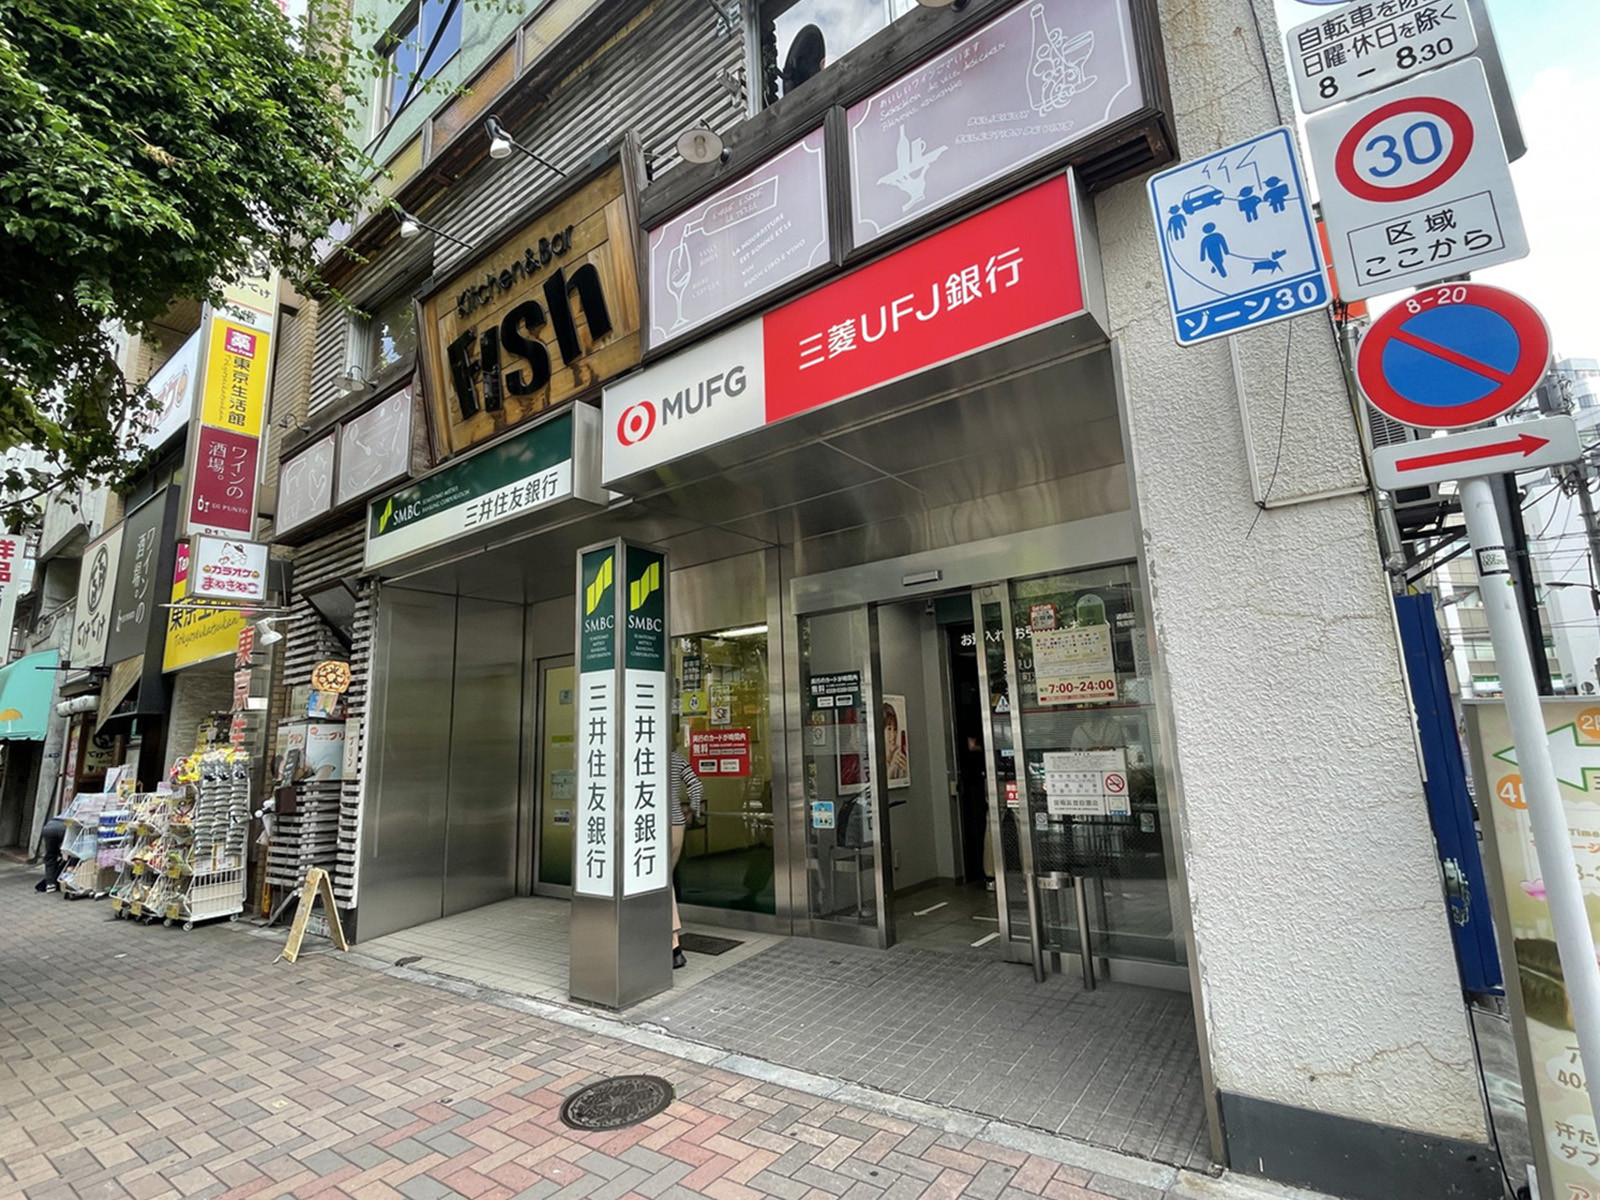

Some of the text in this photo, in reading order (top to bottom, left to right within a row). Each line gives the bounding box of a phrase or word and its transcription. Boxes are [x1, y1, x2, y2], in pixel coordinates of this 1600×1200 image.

[1319, 76, 1339, 99] 8
[1396, 38, 1454, 70] 8.30
[1366, 121, 1443, 177] 30
[1386, 208, 1457, 246] 区域
[1366, 229, 1493, 277] ここから
[799, 247, 1024, 370] 三菱UFJ銀行
[1184, 281, 1318, 337] ゾーン30
[1405, 286, 1467, 314] 8-20
[230, 331, 252, 351] 薬
[228, 356, 252, 427] 東京生活館
[662, 365, 746, 426] MUFG
[207, 441, 228, 481] 酒場。
[226, 446, 248, 499] ワインの
[393, 501, 421, 526] SMBC
[464, 471, 558, 527] 三井住友銀行
[202, 576, 259, 595] まねきねこ
[211, 565, 253, 578] カラオケ
[584, 614, 614, 634] SMBC
[628, 614, 662, 633] SMBC
[586, 685, 608, 879] 三井住友銀行
[633, 684, 657, 877] 三井住友銀行
